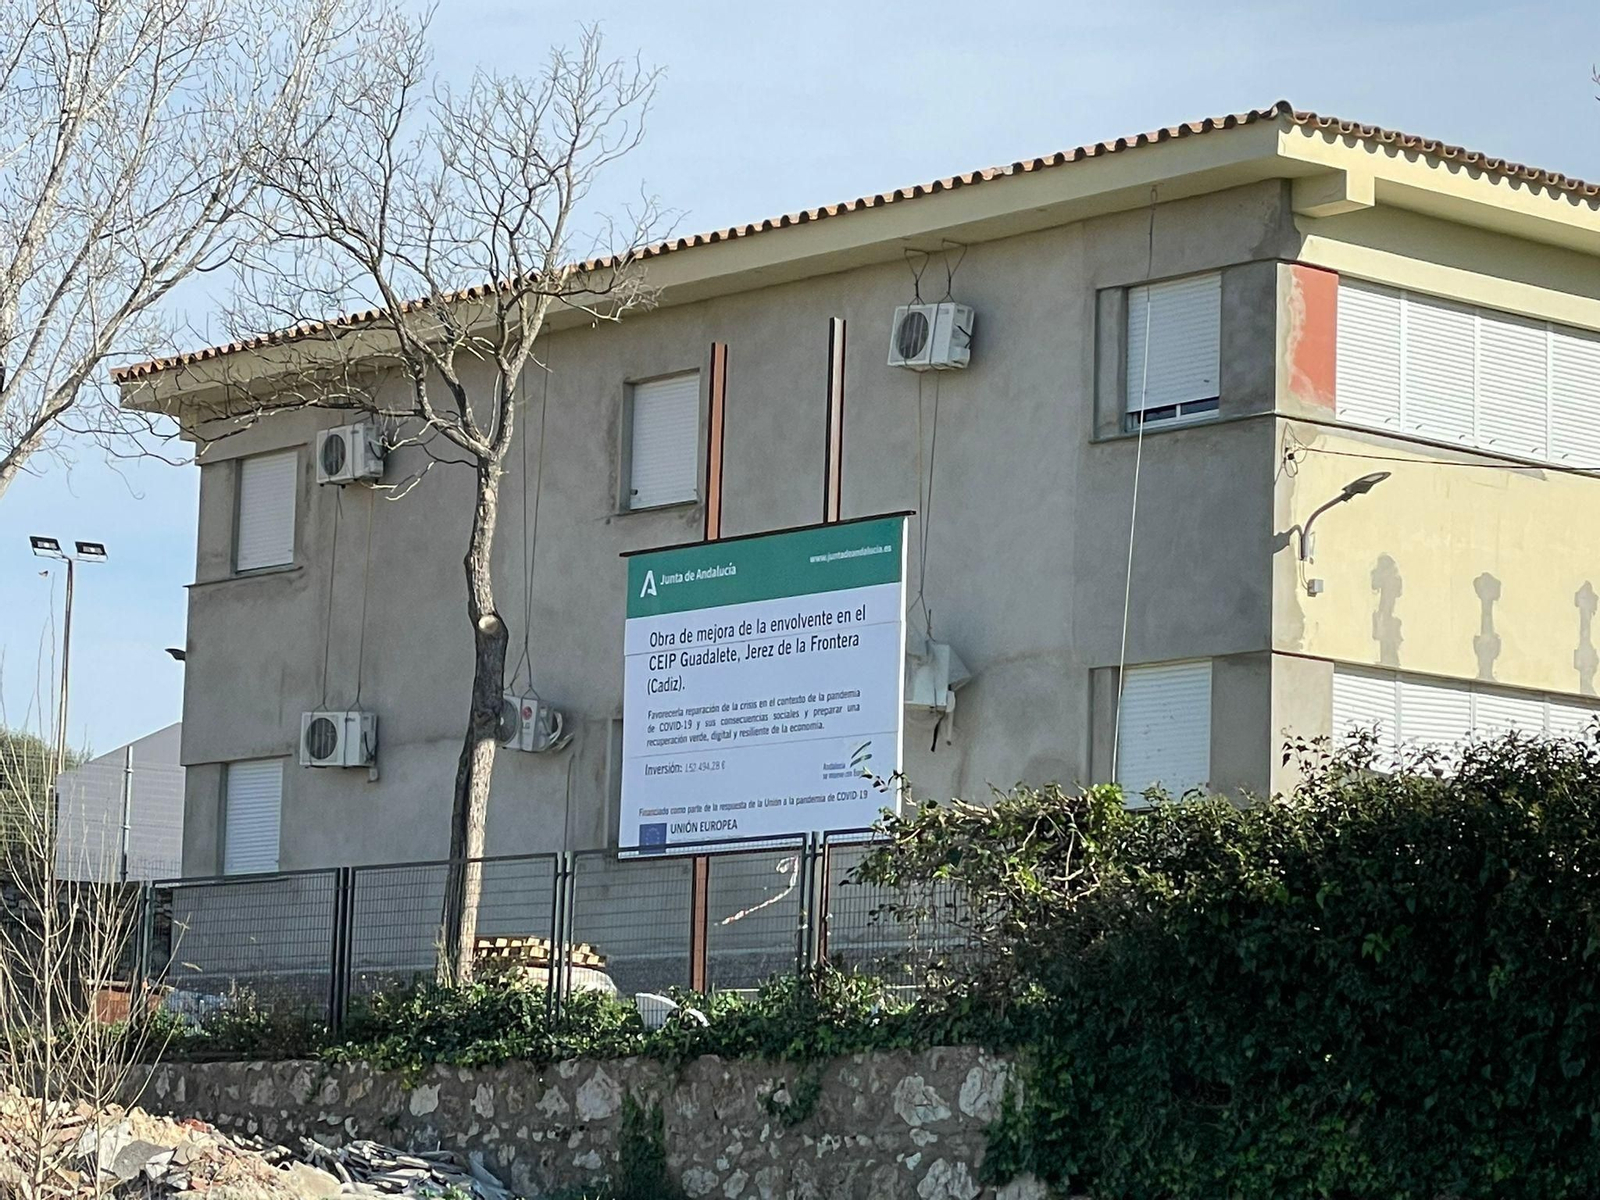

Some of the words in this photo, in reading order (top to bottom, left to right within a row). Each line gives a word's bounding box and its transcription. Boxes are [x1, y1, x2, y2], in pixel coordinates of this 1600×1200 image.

[660, 572, 683, 586] Junta
[685, 570, 695, 581] de
[696, 562, 737, 580] Andalucía
[650, 631, 676, 648] Obra
[679, 627, 693, 644] de
[696, 624, 734, 644] mejora
[738, 620, 752, 636] de
[756, 618, 767, 634] la
[770, 610, 832, 632] envolvente
[836, 610, 851, 625] en
[856, 604, 866, 621] el
[649, 652, 676, 672] CEIP
[680, 646, 741, 668] Guadalete,
[745, 642, 774, 660] Jerez
[778, 638, 792, 655] de
[796, 637, 806, 653] la
[811, 634, 859, 652] Frontera
[647, 674, 686, 695] (Cadiz).
[722, 703, 730, 712] de
[732, 702, 738, 711] la
[740, 700, 758, 710] crisis
[759, 700, 768, 708] en
[769, 697, 776, 707] el
[777, 694, 806, 706] contexto
[808, 694, 816, 703] de
[818, 692, 825, 702] la
[826, 689, 860, 702] pandemia
[647, 724, 656, 734] de
[659, 720, 692, 732] COVID-19
[696, 721, 700, 730] y
[705, 718, 716, 728] sus
[720, 712, 768, 726] consecuencias
[773, 710, 800, 720] sociales
[804, 710, 808, 719] y
[814, 706, 843, 717] preparar
[847, 704, 860, 712] una
[711, 730, 732, 742] digital
[733, 730, 738, 740] y
[739, 726, 770, 738] resiliente
[771, 724, 780, 734] de
[782, 724, 788, 733] la
[644, 762, 682, 776] Inversión:
[638, 806, 669, 816] Financiado
[670, 806, 686, 815] como
[688, 805, 702, 815] parte
[704, 803, 712, 812] de
[712, 802, 718, 812] la
[720, 801, 747, 812] respuesta
[748, 800, 756, 808] de
[758, 798, 762, 808] la
[783, 798, 787, 806] a
[788, 796, 794, 806] la
[796, 794, 826, 806] pandemia
[827, 793, 836, 802] de
[670, 820, 698, 834] UNIÓN
[700, 819, 738, 832] EUROPEA
